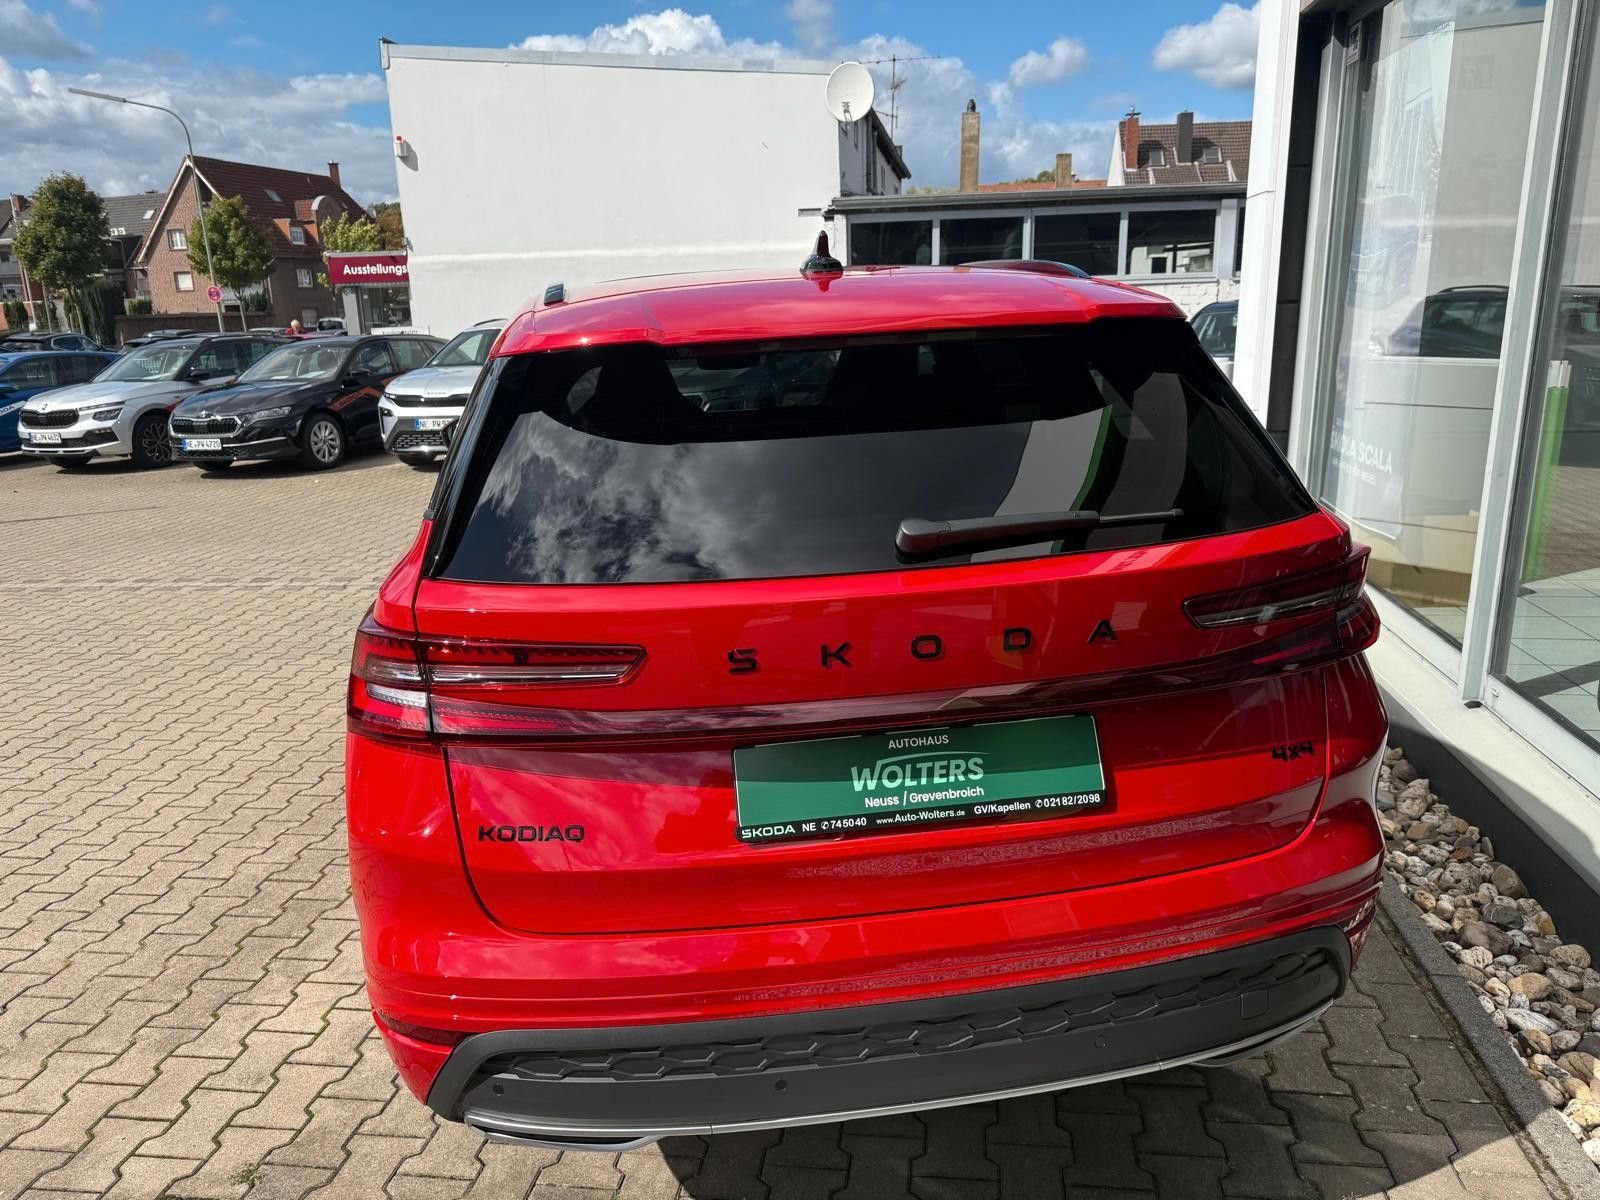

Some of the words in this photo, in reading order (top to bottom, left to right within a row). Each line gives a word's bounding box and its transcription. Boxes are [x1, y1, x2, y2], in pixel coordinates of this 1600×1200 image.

[343, 264, 407, 276] Ausstellungs
[1359, 442, 1392, 475] SCALA
[728, 619, 1118, 674] SKODA
[888, 735, 949, 749] AUTOHAUS
[850, 756, 984, 792] WOLTERS
[864, 796, 900, 808] Neuss
[909, 786, 985, 804] Grevenbroich
[741, 824, 796, 839] SKODA
[802, 823, 816, 832] NE
[830, 817, 867, 830] 745040
[876, 810, 966, 825] www.Auto-Wolters.de
[974, 801, 1031, 815] GV/Kapellen
[1043, 793, 1100, 808] 02182/2098
[478, 824, 585, 842] KODIAQ
